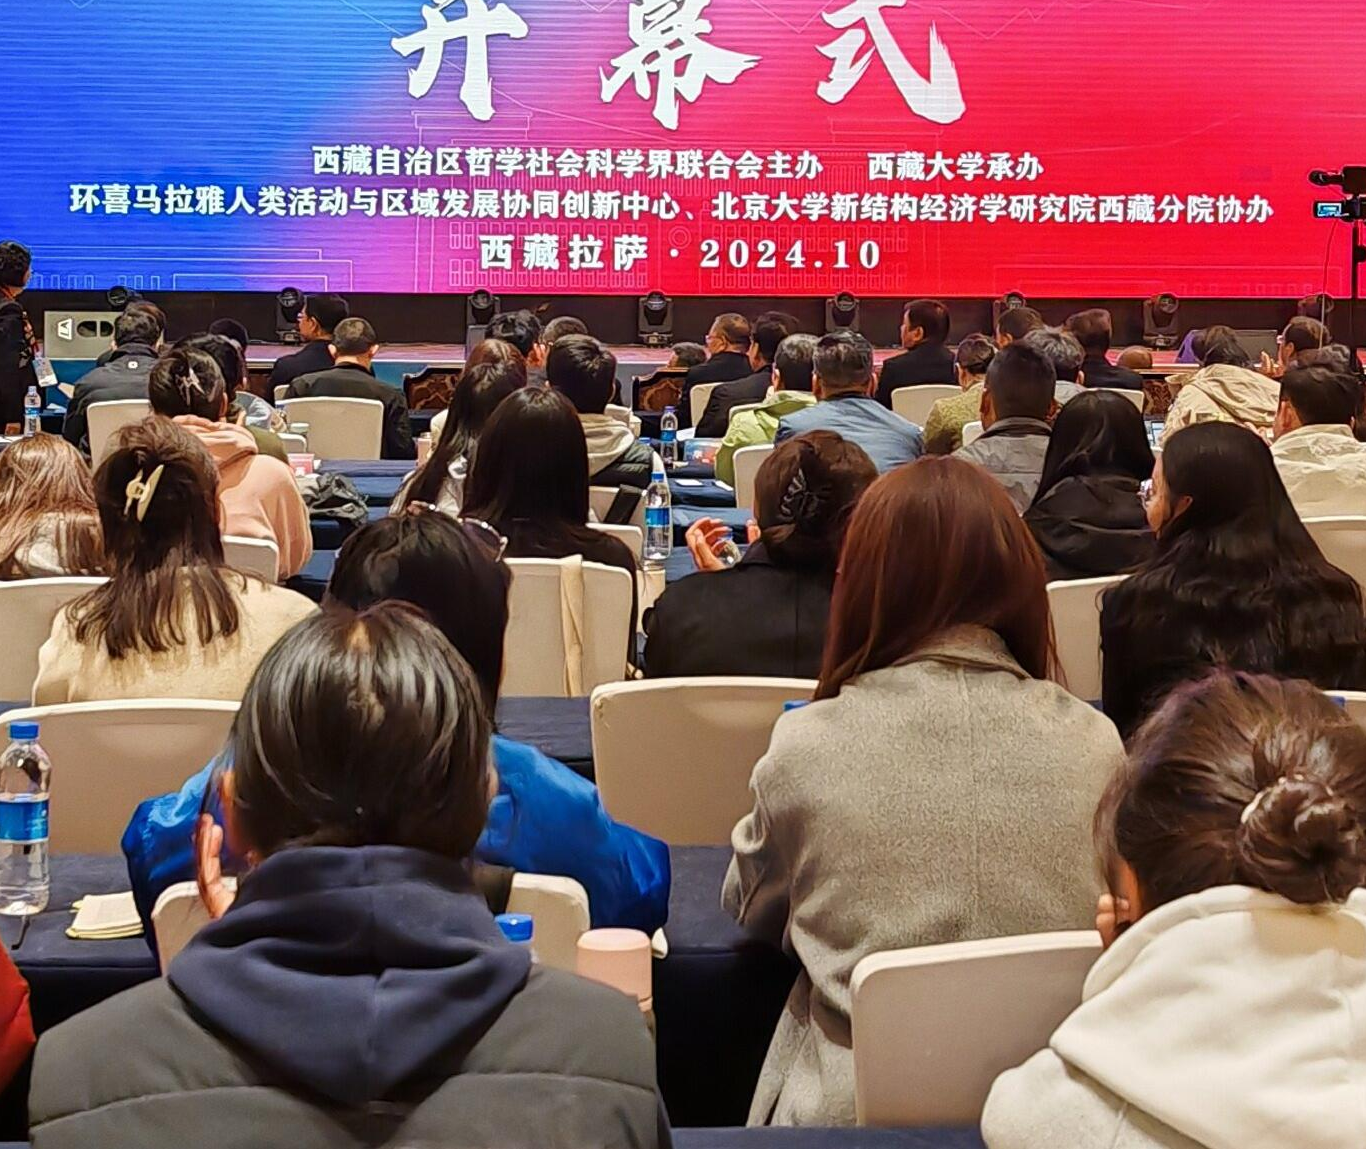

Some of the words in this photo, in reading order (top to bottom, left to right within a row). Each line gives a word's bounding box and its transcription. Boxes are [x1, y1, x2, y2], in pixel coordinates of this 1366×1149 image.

[311, 144, 824, 181] 西藏自治区哲学社会科学界联合会主办
[866, 151, 1045, 182] 西藏大学承办
